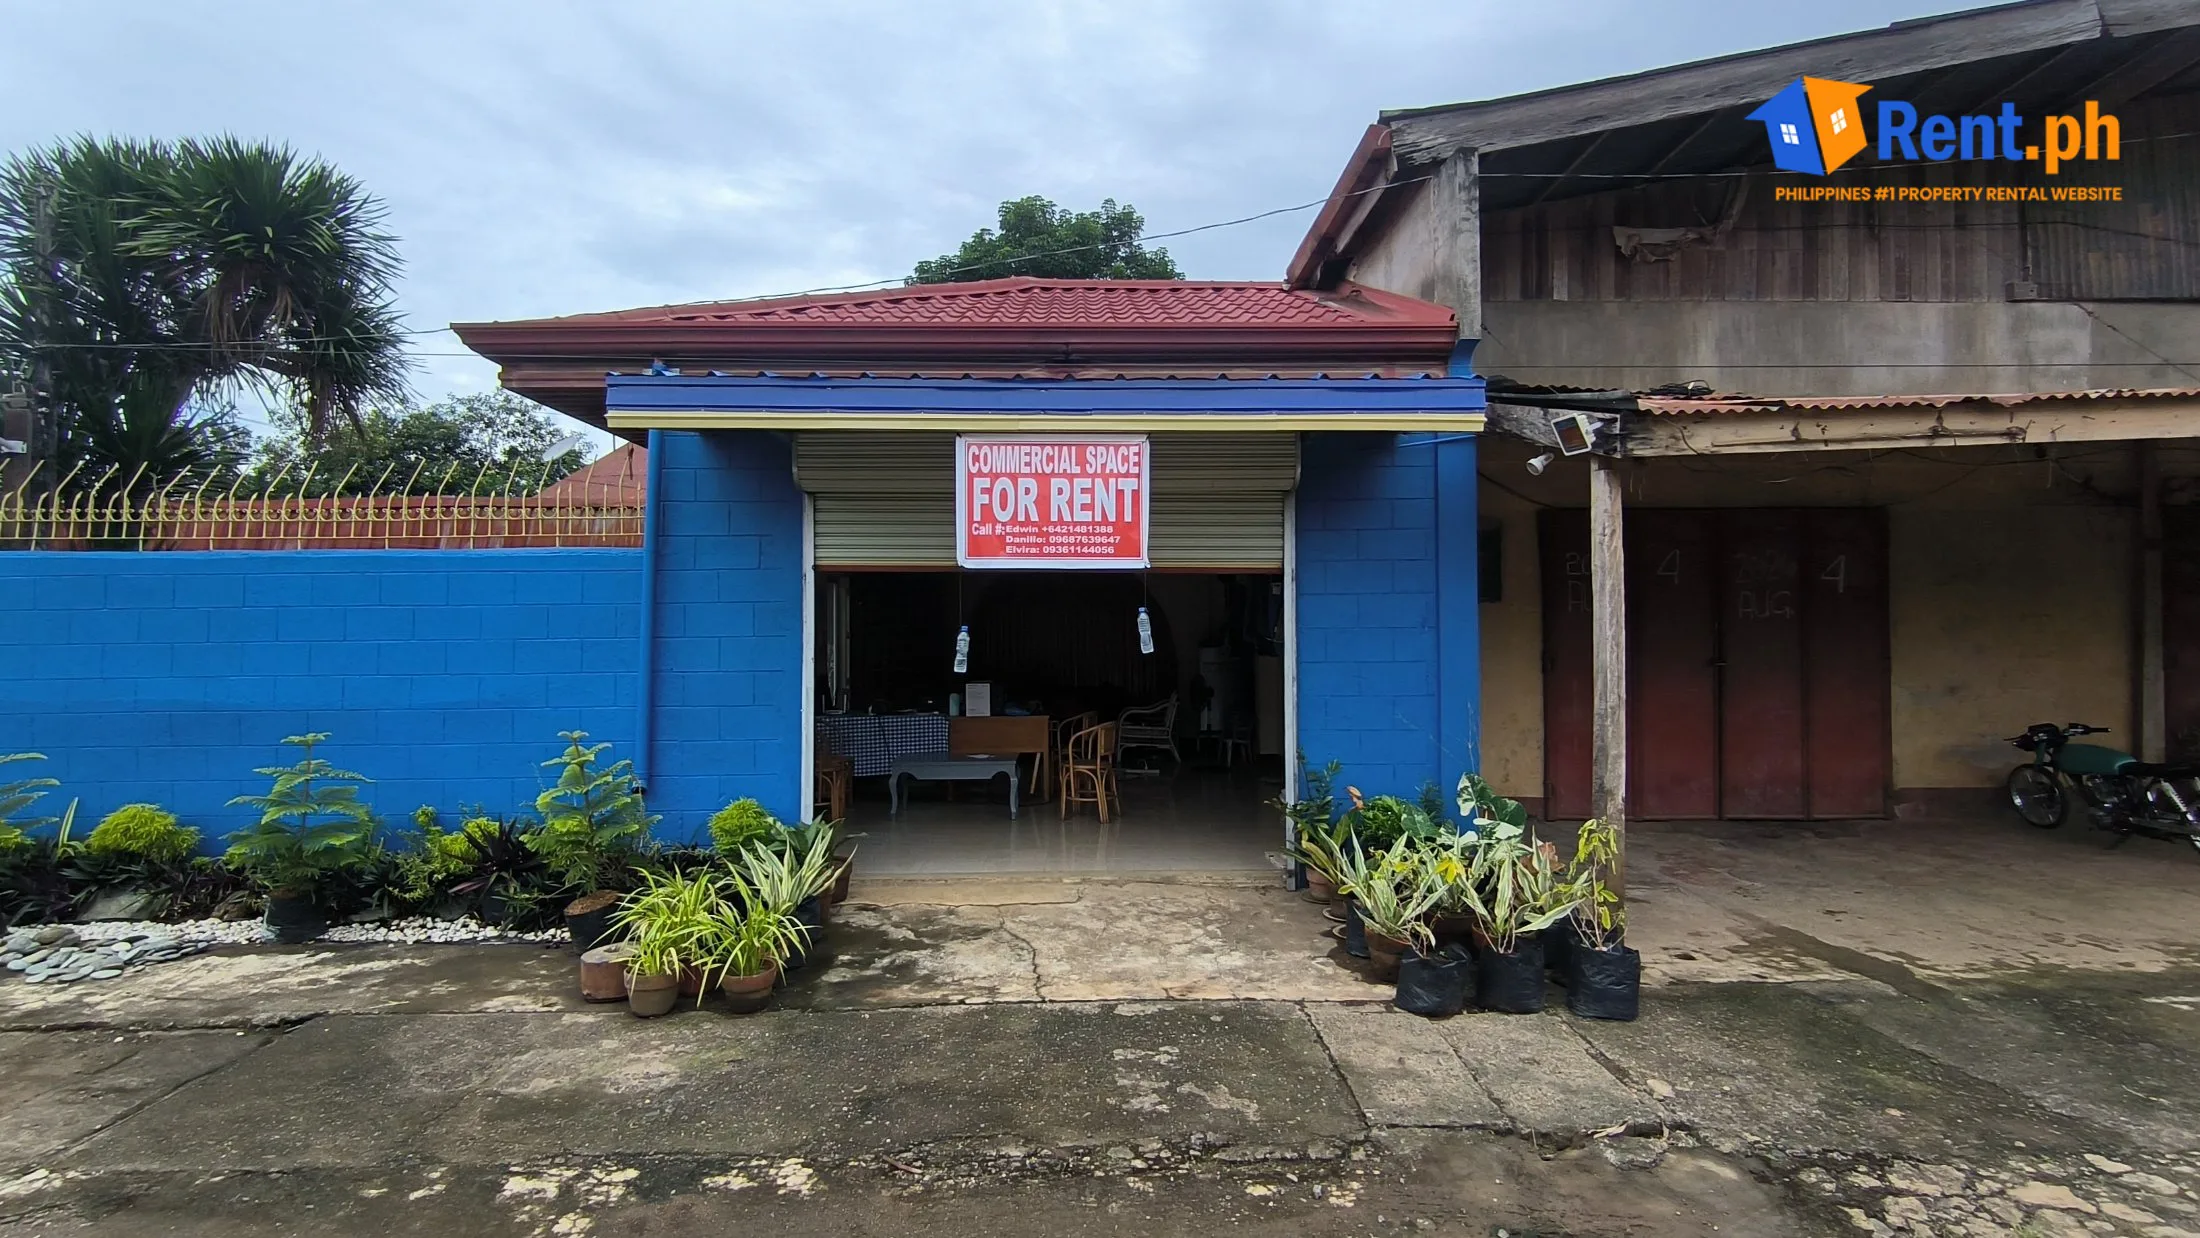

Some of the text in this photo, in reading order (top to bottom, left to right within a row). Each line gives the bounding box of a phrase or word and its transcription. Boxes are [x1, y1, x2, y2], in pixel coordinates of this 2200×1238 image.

[968, 445, 1140, 474] COMMERCIAL SPACE
[973, 476, 1139, 523] FOR RENT
[972, 522, 993, 535] Call
[1005, 525, 1039, 533] Edwin
[1005, 545, 1040, 554] Elvira:
[1820, 554, 1846, 593] 4
